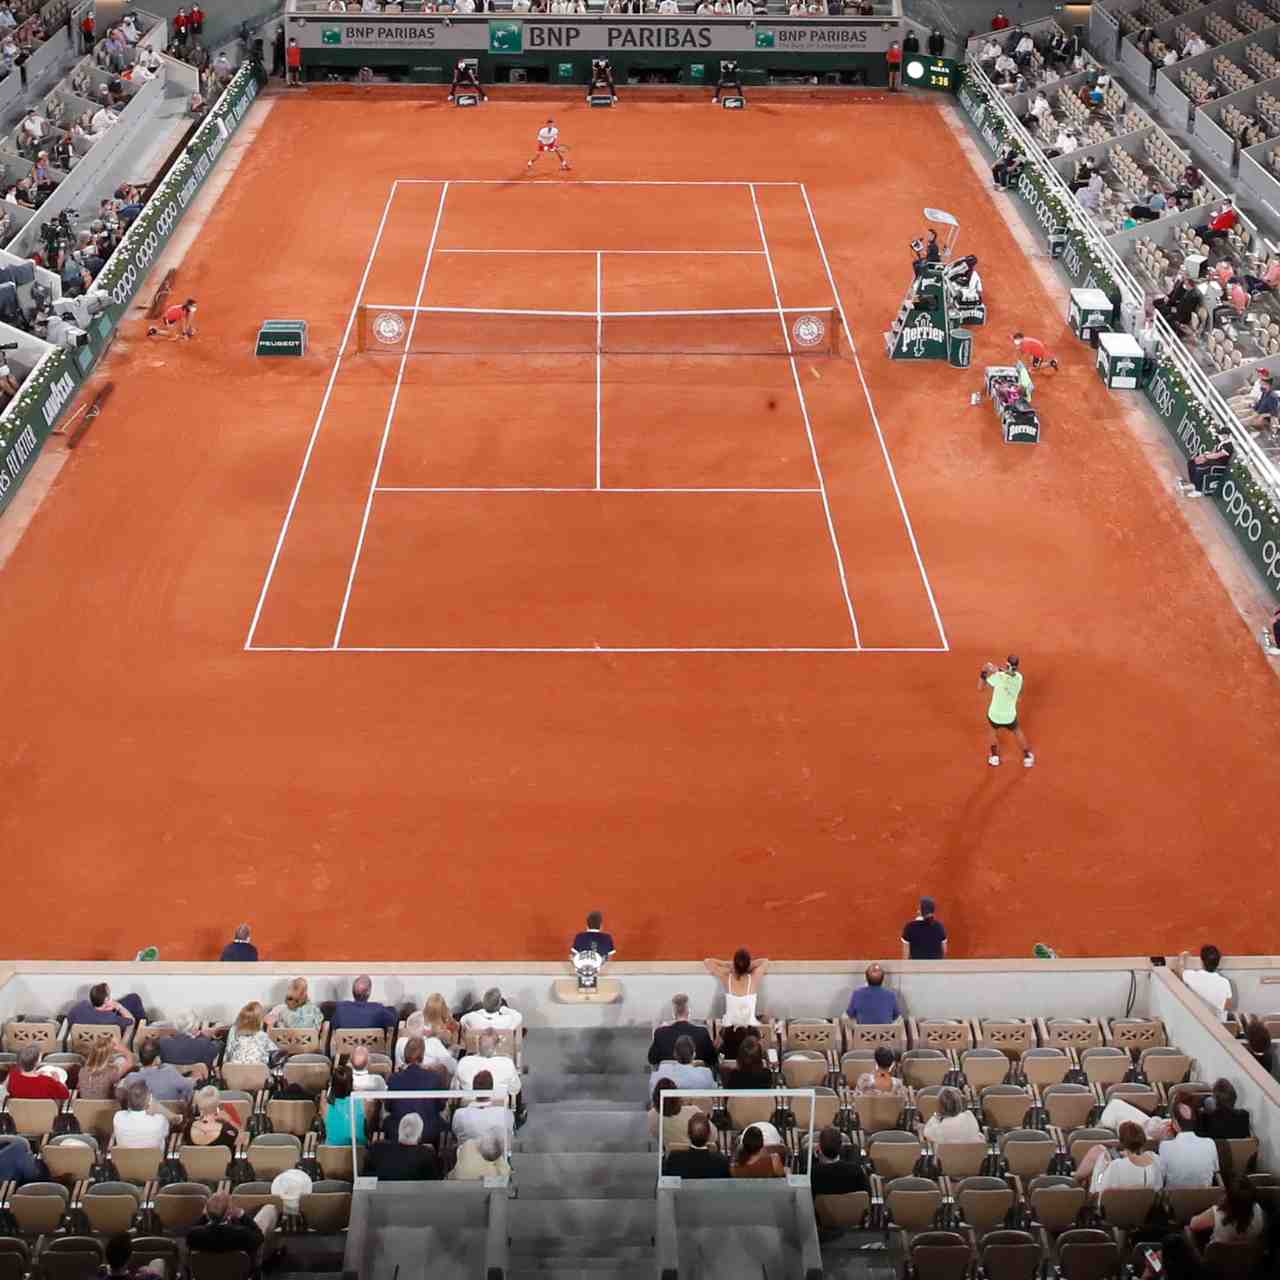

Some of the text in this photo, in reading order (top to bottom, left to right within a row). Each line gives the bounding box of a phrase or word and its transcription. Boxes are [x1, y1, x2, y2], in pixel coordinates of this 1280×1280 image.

[346, 27, 435, 39] BNP PARIBAS
[530, 27, 712, 48] BNP PARIBAS
[779, 31, 867, 42] BNP PARIBAS
[1018, 173, 1037, 205] oppo
[157, 201, 177, 235] oppo
[136, 231, 158, 268] oppo
[112, 264, 136, 304] oppo
[902, 322, 945, 353] perrier
[1222, 480, 1261, 541] oppo
